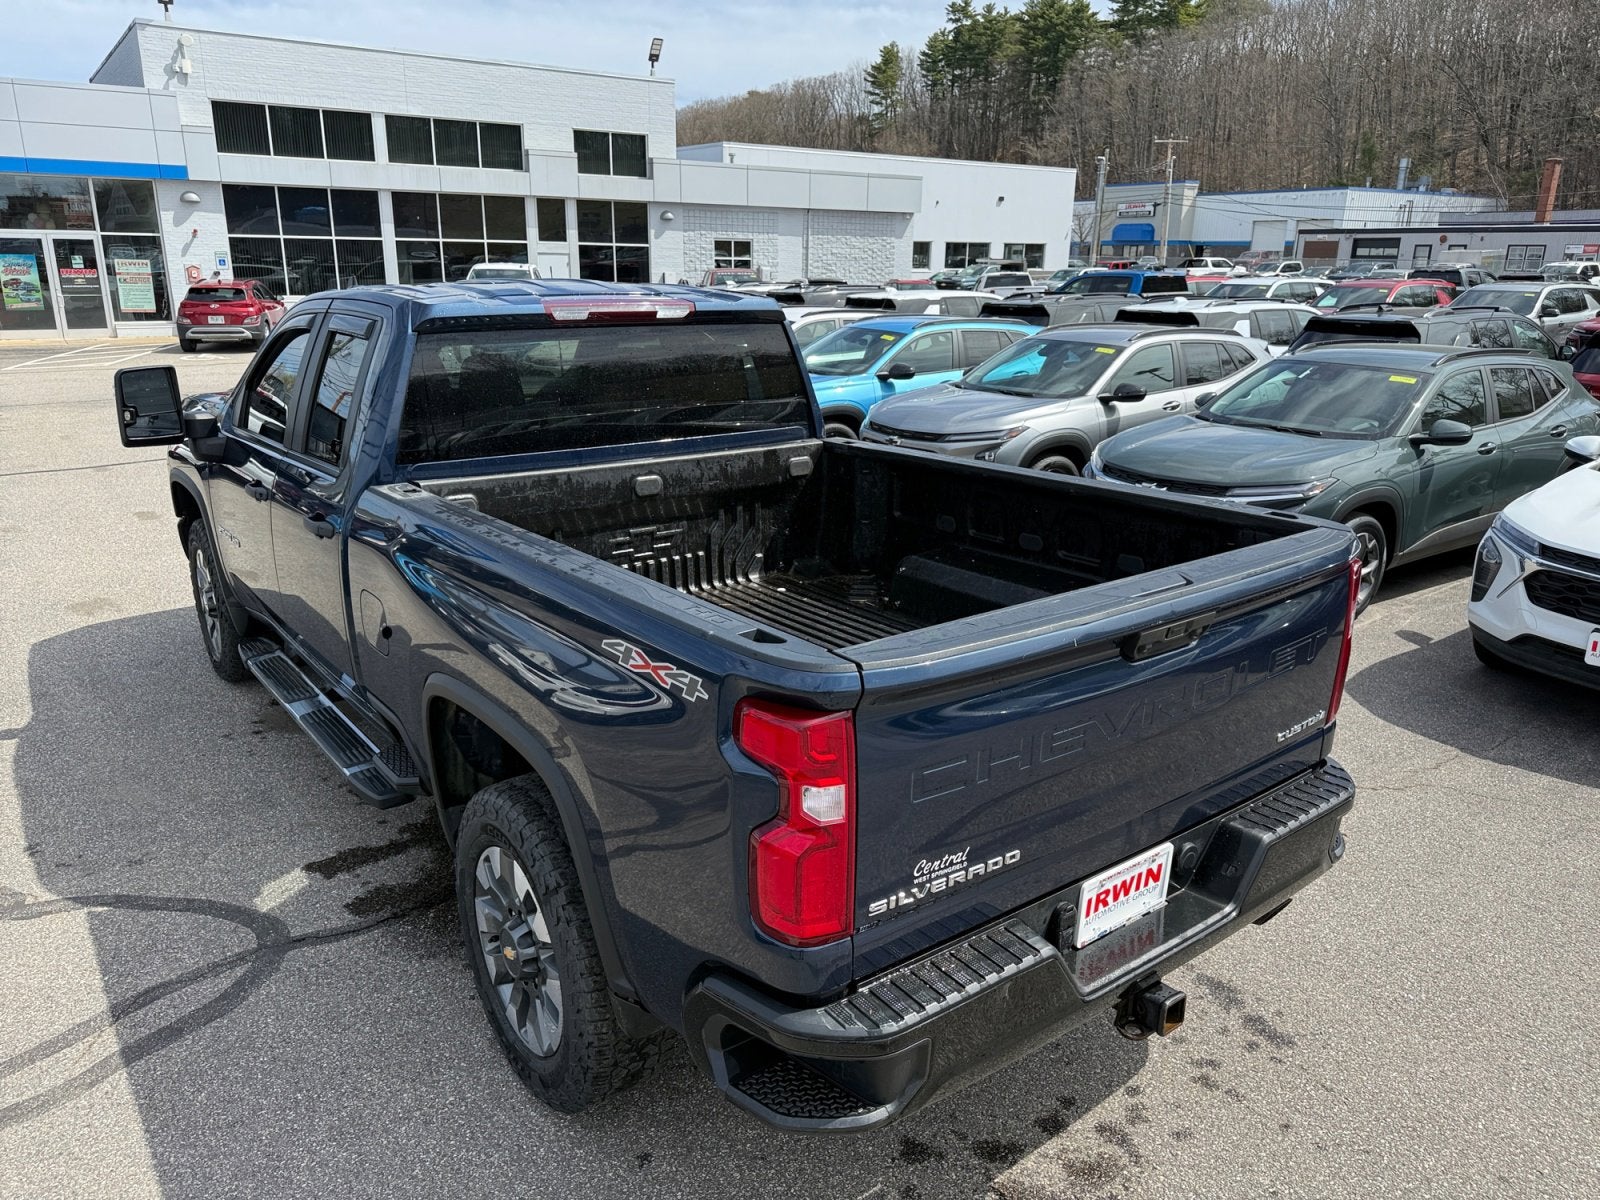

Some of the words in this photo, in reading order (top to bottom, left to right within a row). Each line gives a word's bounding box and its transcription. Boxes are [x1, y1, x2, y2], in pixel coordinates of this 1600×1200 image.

[910, 626, 1328, 804] CHEVROLET
[1277, 709, 1326, 743] CUSTOM
[868, 849, 1021, 917] SILVERADO
[913, 846, 970, 877] Central
[913, 874, 930, 885] WEST
[930, 861, 968, 879] SPRINGFIELD
[1083, 896, 1131, 929] AUTOMOTIVE
[1132, 884, 1160, 902] GROUP
[1084, 863, 1164, 919] IRWIN
